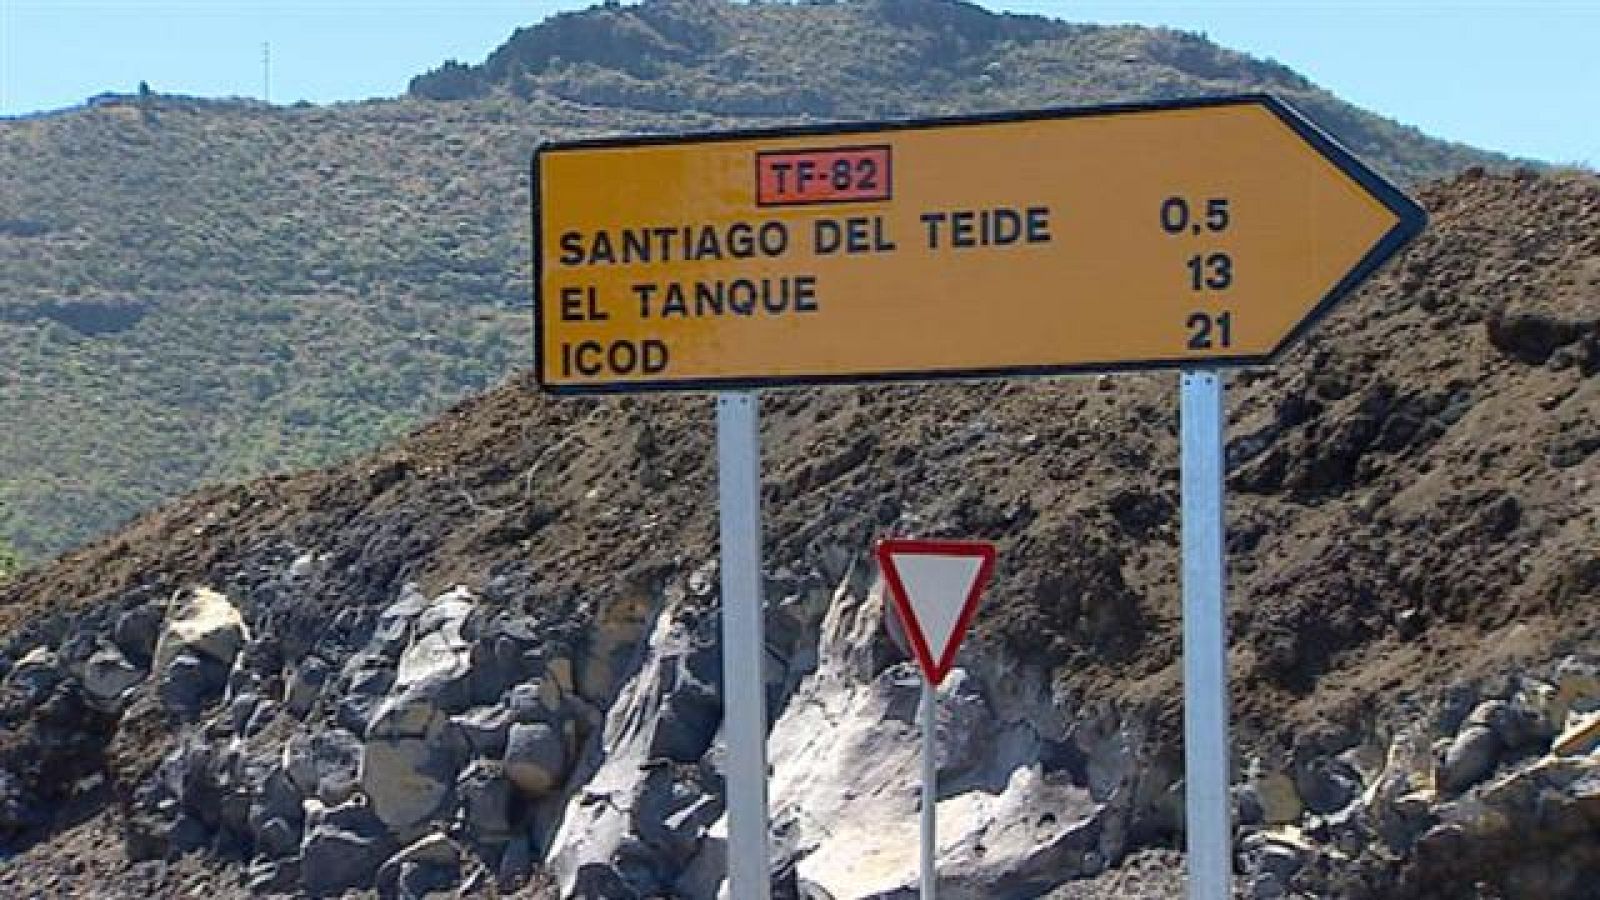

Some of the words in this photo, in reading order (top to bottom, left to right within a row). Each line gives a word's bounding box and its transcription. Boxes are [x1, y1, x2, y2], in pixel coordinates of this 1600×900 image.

[771, 157, 879, 194] TF-82
[1160, 197, 1232, 236] 0,5
[559, 220, 789, 266] SANTIAGO
[814, 216, 897, 255] DEL
[919, 207, 1052, 249] TEIDE
[1187, 253, 1233, 290] 13
[559, 285, 610, 323] EL
[631, 277, 819, 320] TANQUE
[1185, 310, 1231, 351] 21
[560, 340, 670, 377] ICOD
